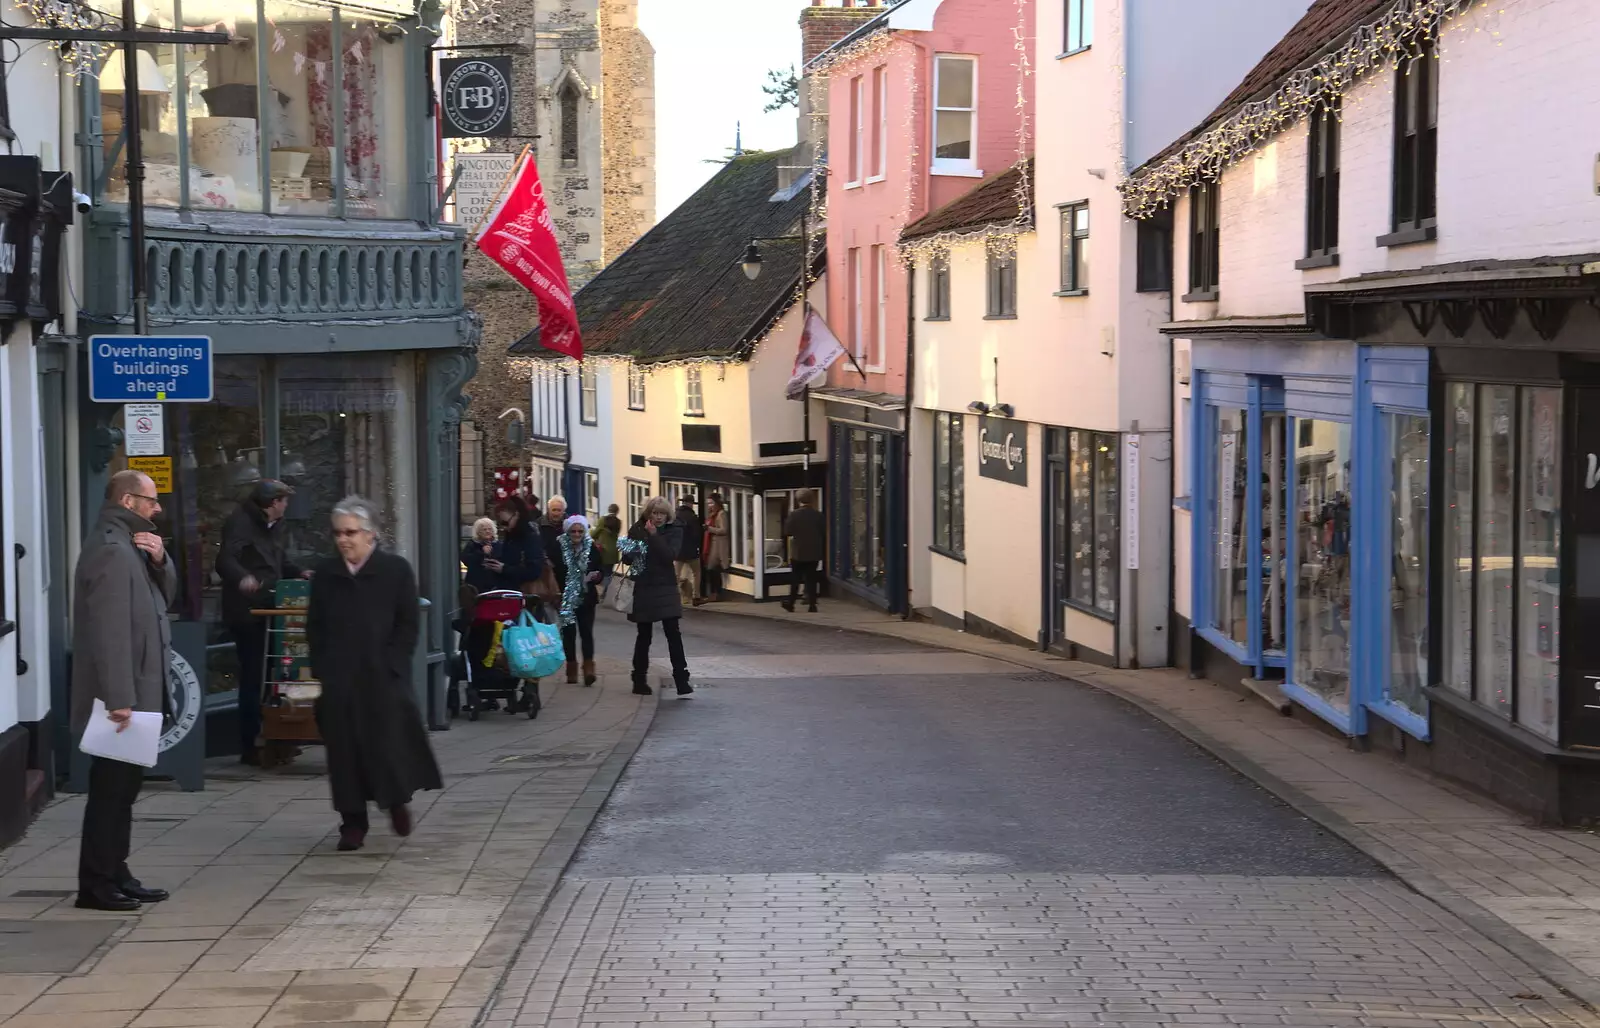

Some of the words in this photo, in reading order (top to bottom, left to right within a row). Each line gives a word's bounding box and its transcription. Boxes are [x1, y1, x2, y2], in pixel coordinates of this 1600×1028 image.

[447, 63, 478, 93] FARROW
[488, 69, 505, 92] BALL
[459, 86, 494, 109] F&B
[448, 106, 470, 129] PAINT
[483, 106, 505, 129] PAPER
[98, 343, 203, 360] Overhanging
[113, 362, 189, 377] buildings
[126, 378, 177, 392] ahead
